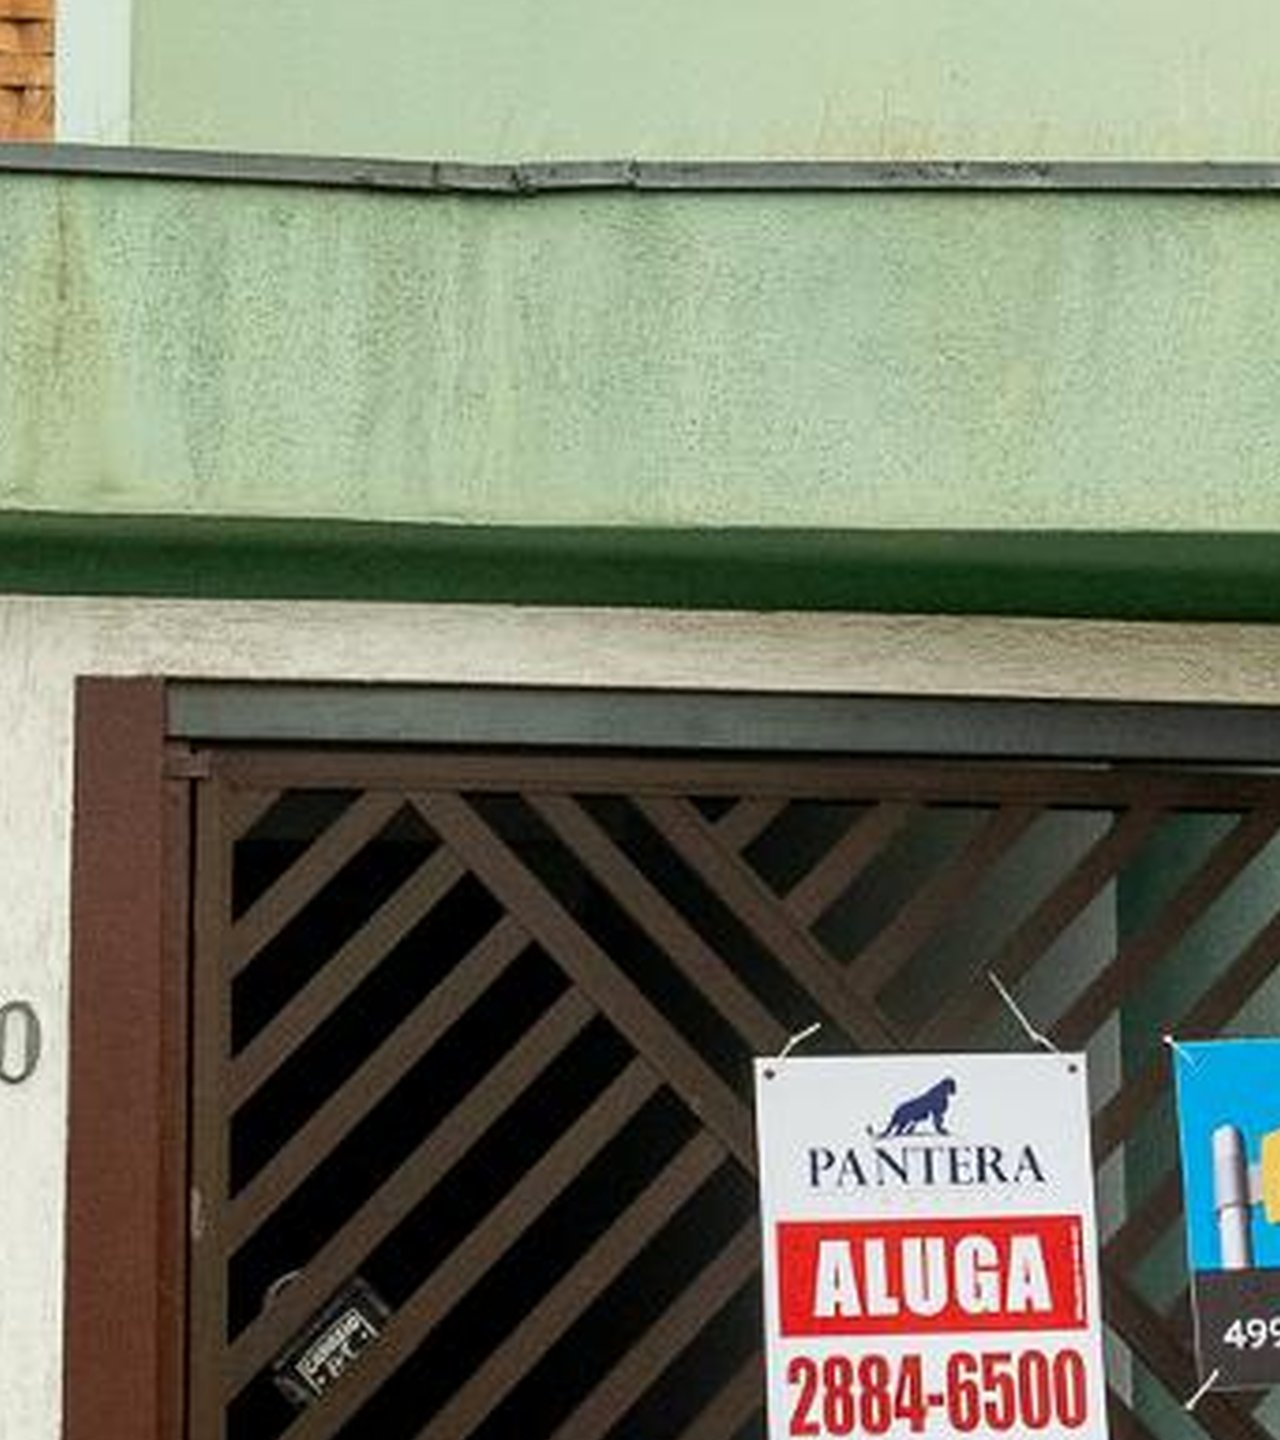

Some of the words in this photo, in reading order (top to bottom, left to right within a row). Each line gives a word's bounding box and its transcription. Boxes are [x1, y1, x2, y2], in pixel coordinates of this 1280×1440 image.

[808, 1144, 1046, 1187] PANTERA
[814, 1234, 1053, 1317] ALUGA
[787, 1349, 1088, 1436] 2884-6500
